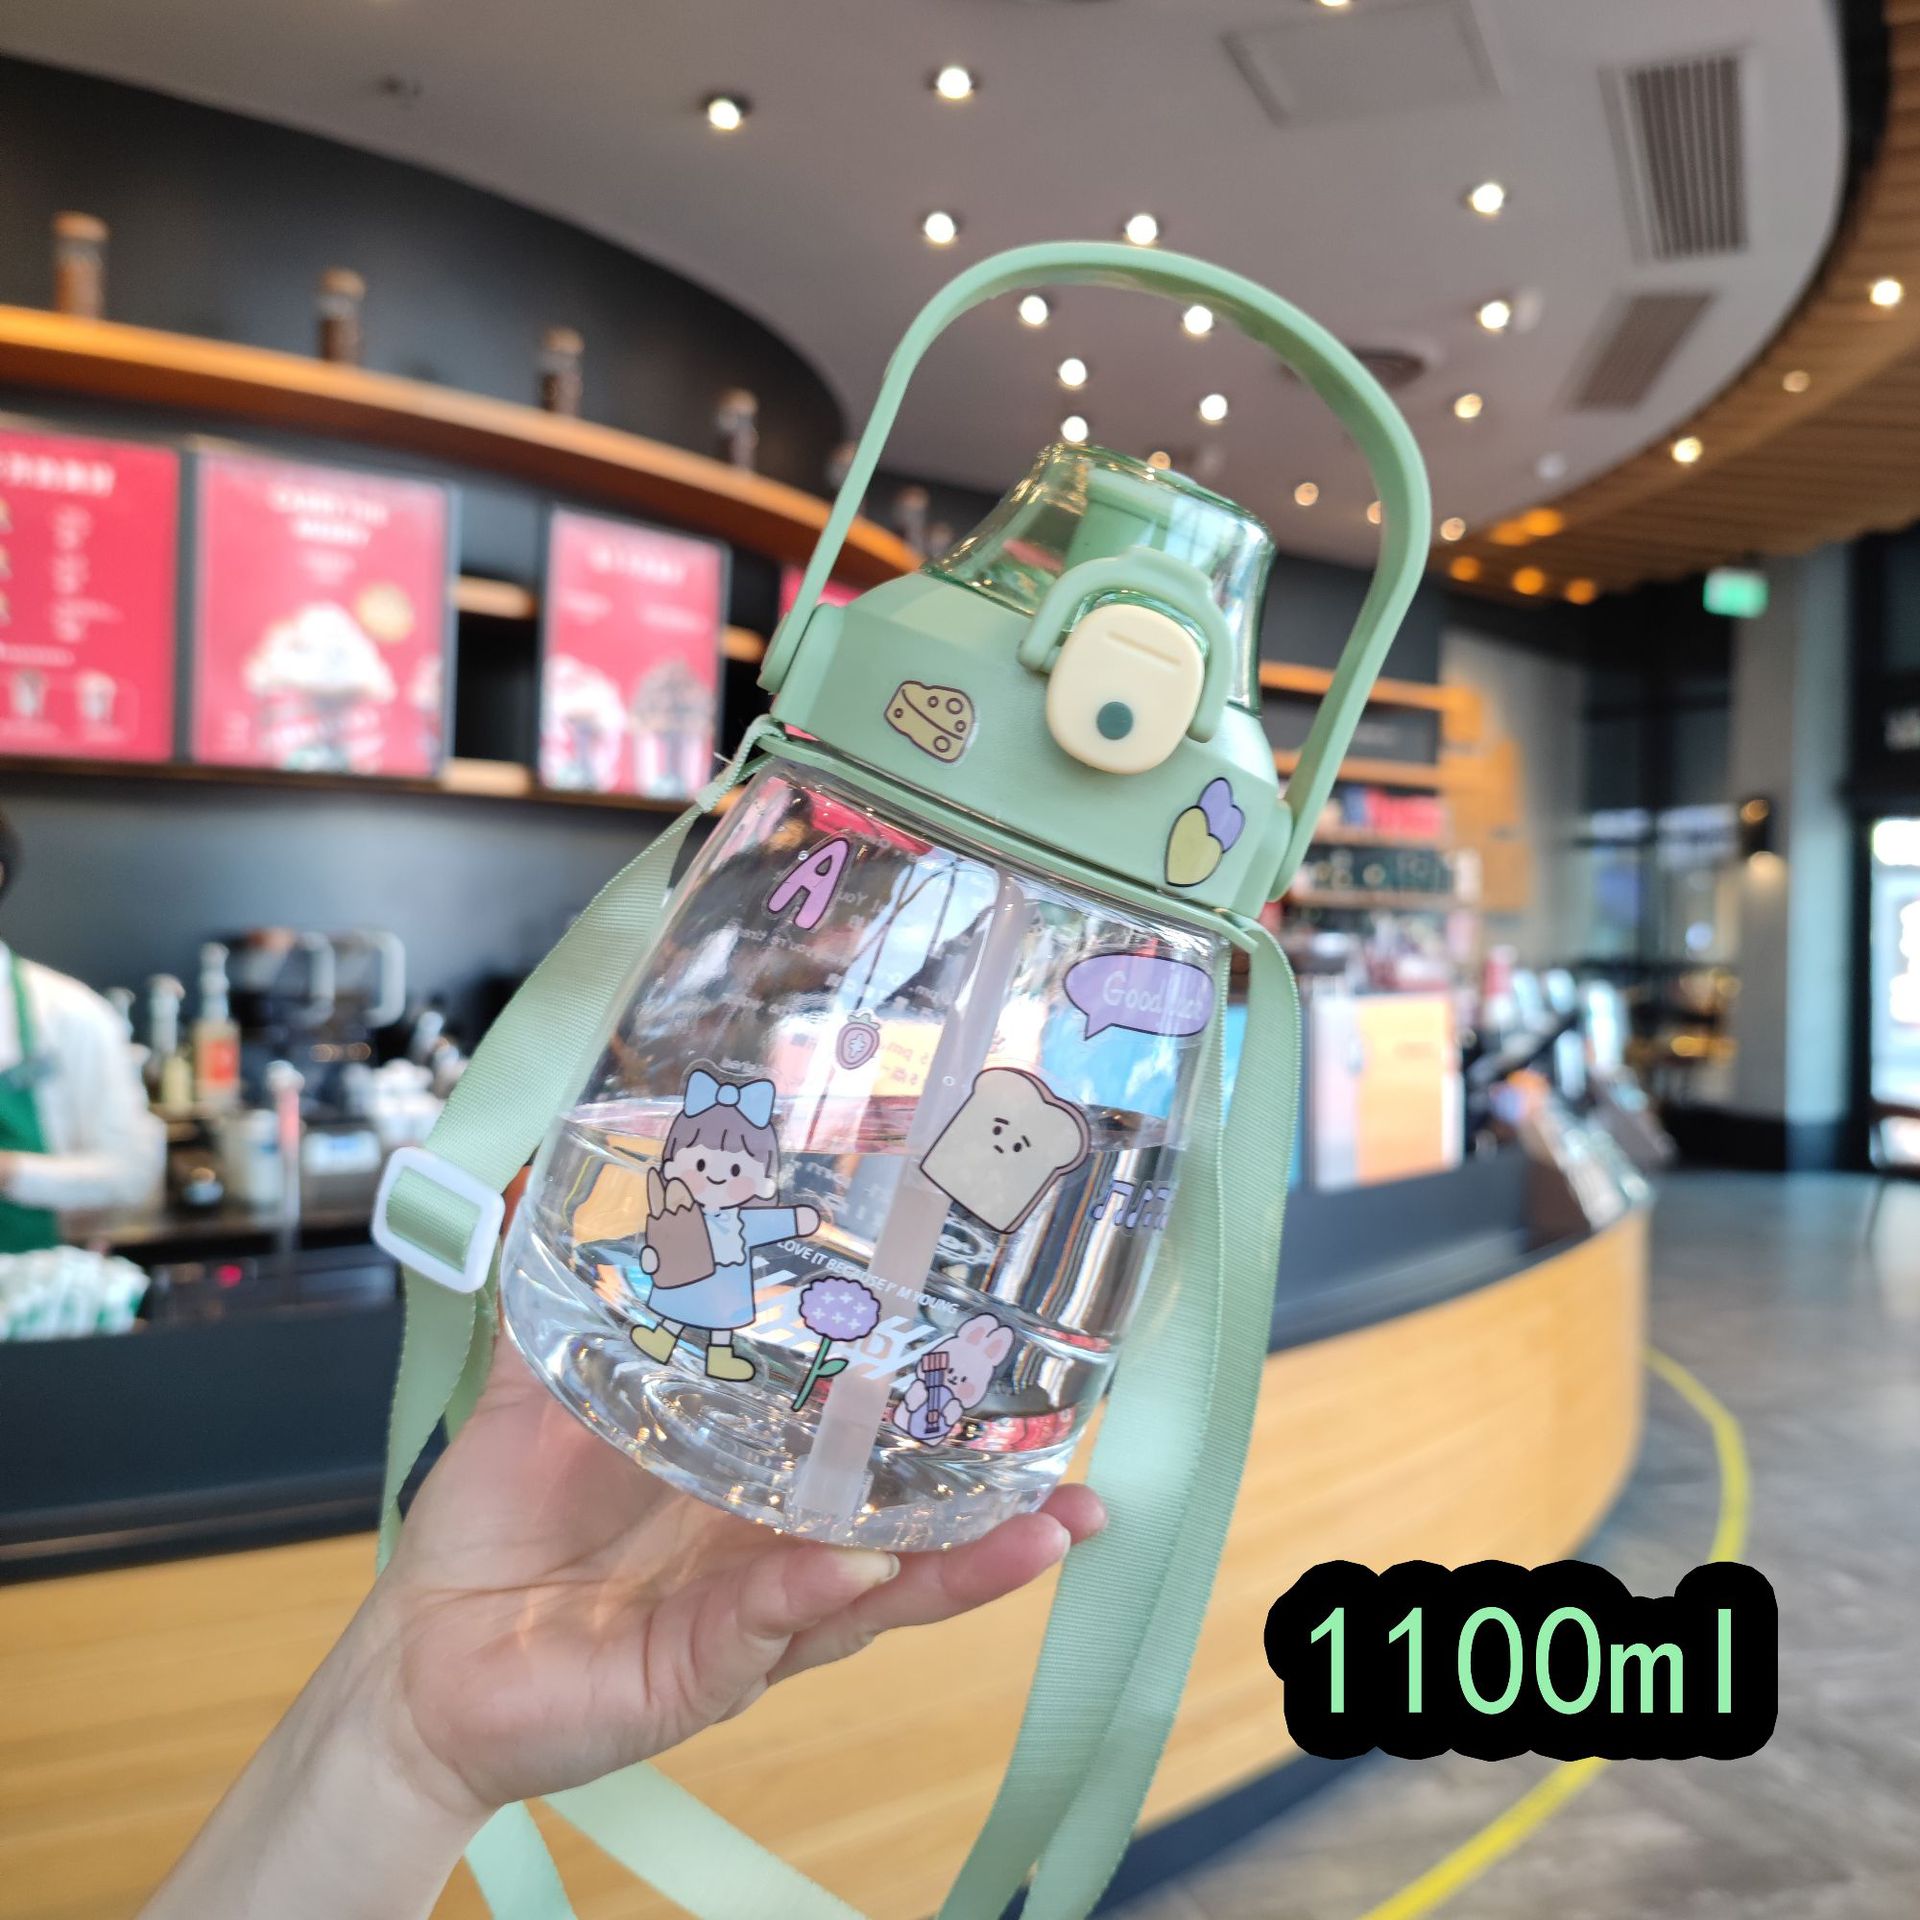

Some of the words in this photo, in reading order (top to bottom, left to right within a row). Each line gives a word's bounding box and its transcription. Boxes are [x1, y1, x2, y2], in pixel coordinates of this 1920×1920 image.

[1102, 970, 1166, 1014] Good
[777, 1240, 813, 1260] LOVE
[811, 1252, 828, 1266] IT
[826, 1258, 887, 1291] BECAUSE
[912, 1291, 960, 1314] YOUNG
